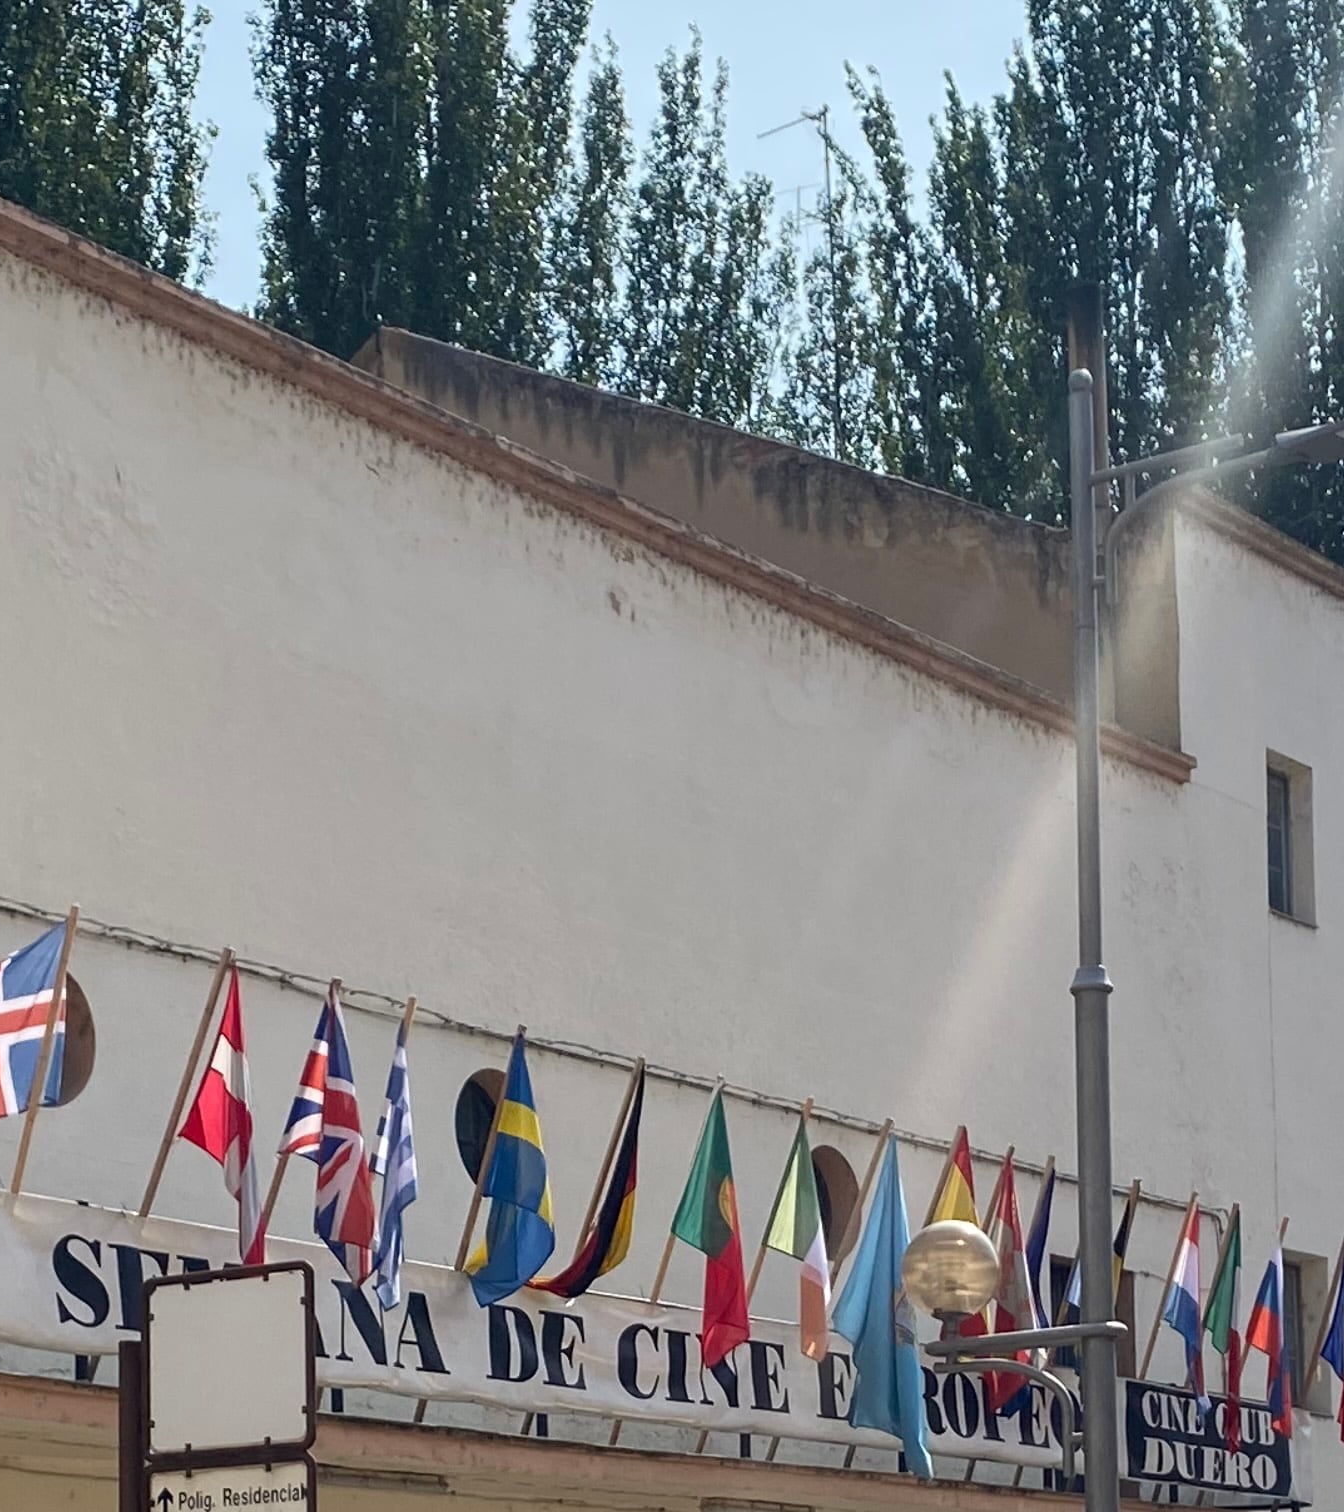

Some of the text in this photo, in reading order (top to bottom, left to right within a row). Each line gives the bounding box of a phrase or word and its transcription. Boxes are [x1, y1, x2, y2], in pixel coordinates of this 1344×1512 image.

[487, 1304, 587, 1390] DE
[617, 1323, 791, 1414] CINE
[1142, 1389, 1276, 1447] CINE CUB
[1141, 1436, 1278, 1490] DUERO
[178, 1483, 306, 1512] Polig. Residencial
